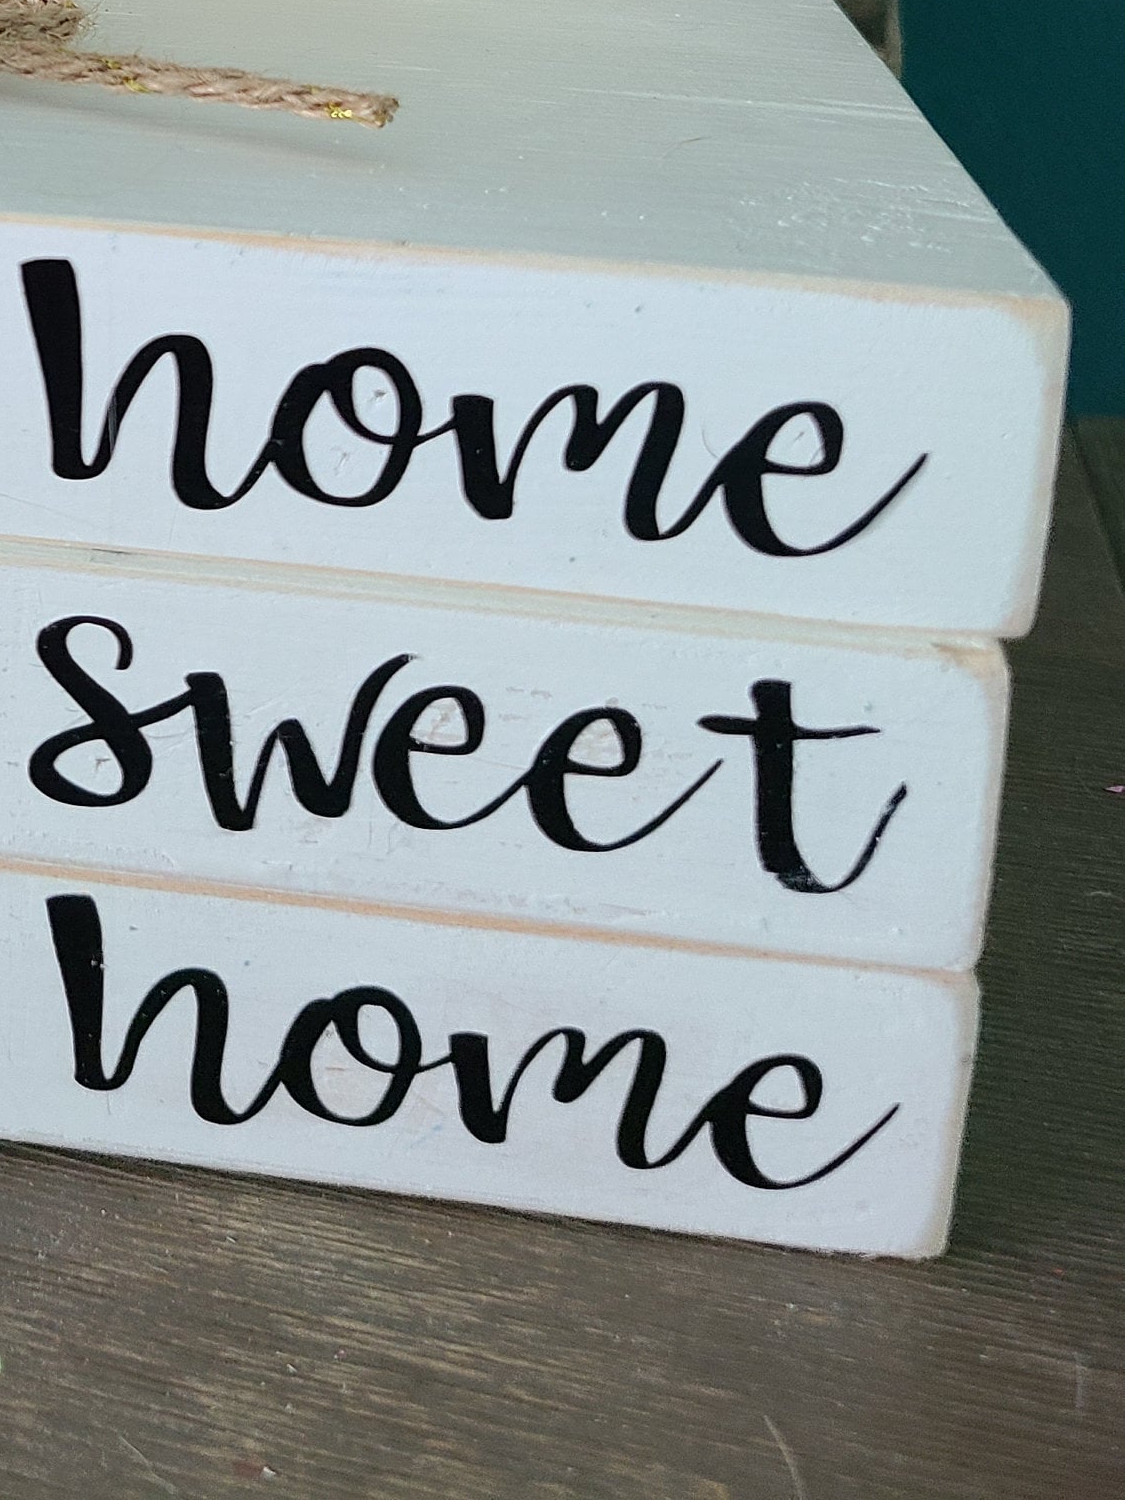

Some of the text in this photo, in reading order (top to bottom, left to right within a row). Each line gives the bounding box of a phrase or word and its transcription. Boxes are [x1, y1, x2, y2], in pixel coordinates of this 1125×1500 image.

[20, 258, 927, 557] home
[28, 615, 907, 894] sweet
[46, 894, 900, 1191] home
